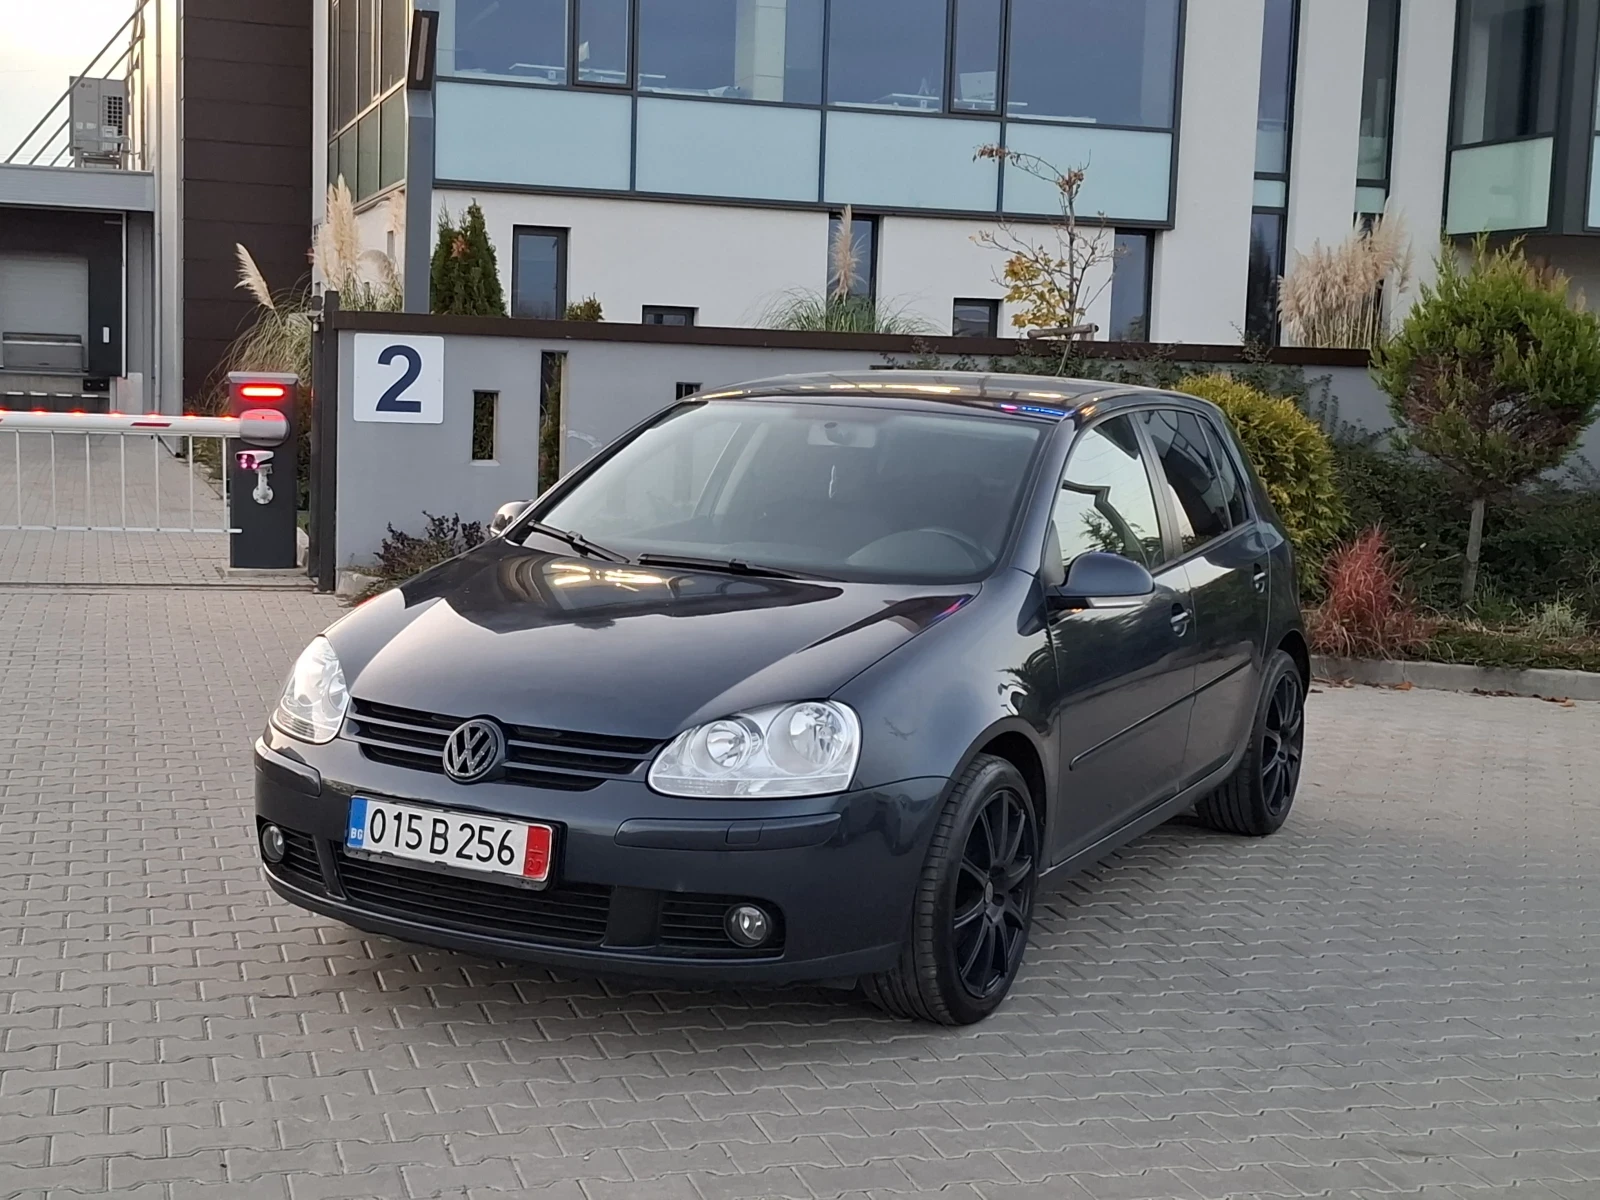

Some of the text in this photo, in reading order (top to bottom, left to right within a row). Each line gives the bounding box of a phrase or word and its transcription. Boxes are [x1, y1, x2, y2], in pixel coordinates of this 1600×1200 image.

[376, 345, 422, 413] 2
[446, 721, 498, 780] VW
[351, 827, 363, 840] BG
